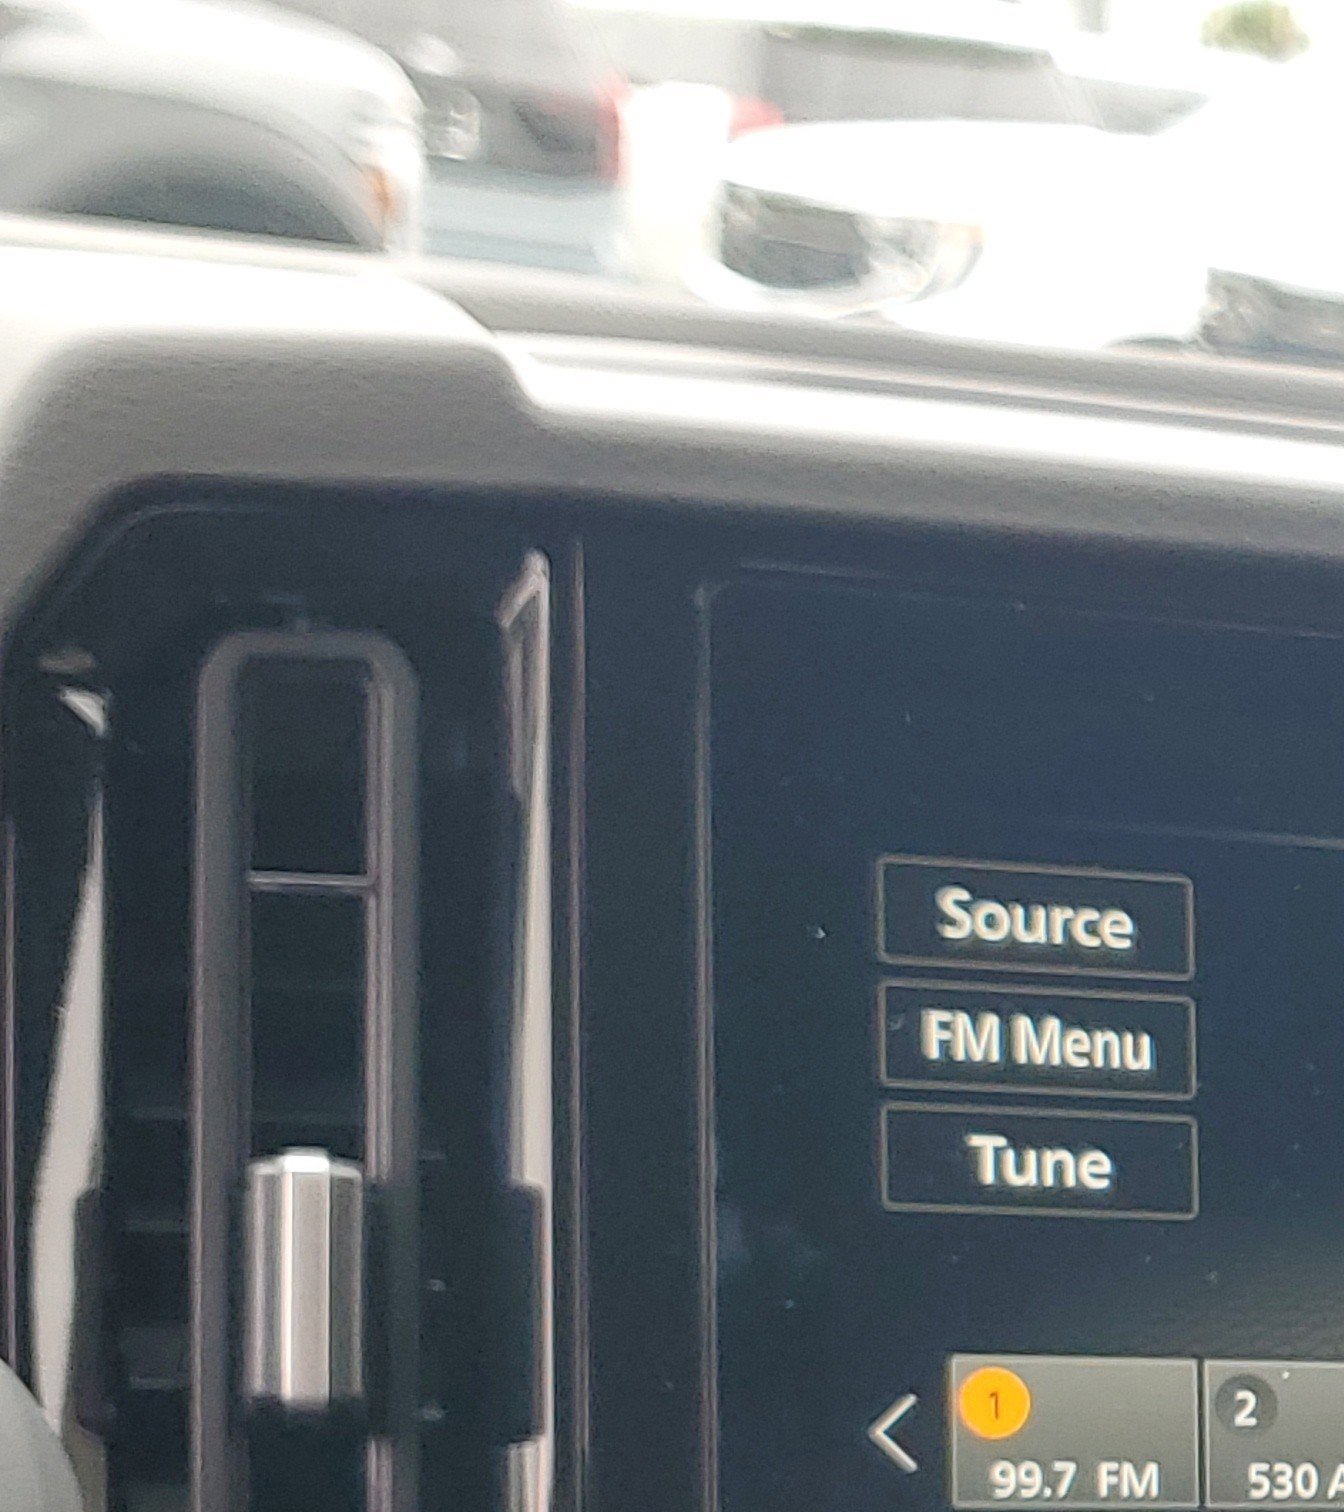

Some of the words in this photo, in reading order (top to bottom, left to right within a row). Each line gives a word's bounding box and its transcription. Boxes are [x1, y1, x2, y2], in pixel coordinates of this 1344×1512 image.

[935, 884, 1135, 950] Source
[920, 1008, 1001, 1064] FM
[1009, 1013, 1155, 1072] Menu
[964, 1134, 1114, 1190] Tune
[989, 1391, 1000, 1421] 1
[1233, 1390, 1259, 1428] 2
[989, 1460, 1077, 1499] 99.7
[1097, 1461, 1160, 1499] FM
[1247, 1462, 1319, 1499] 530
